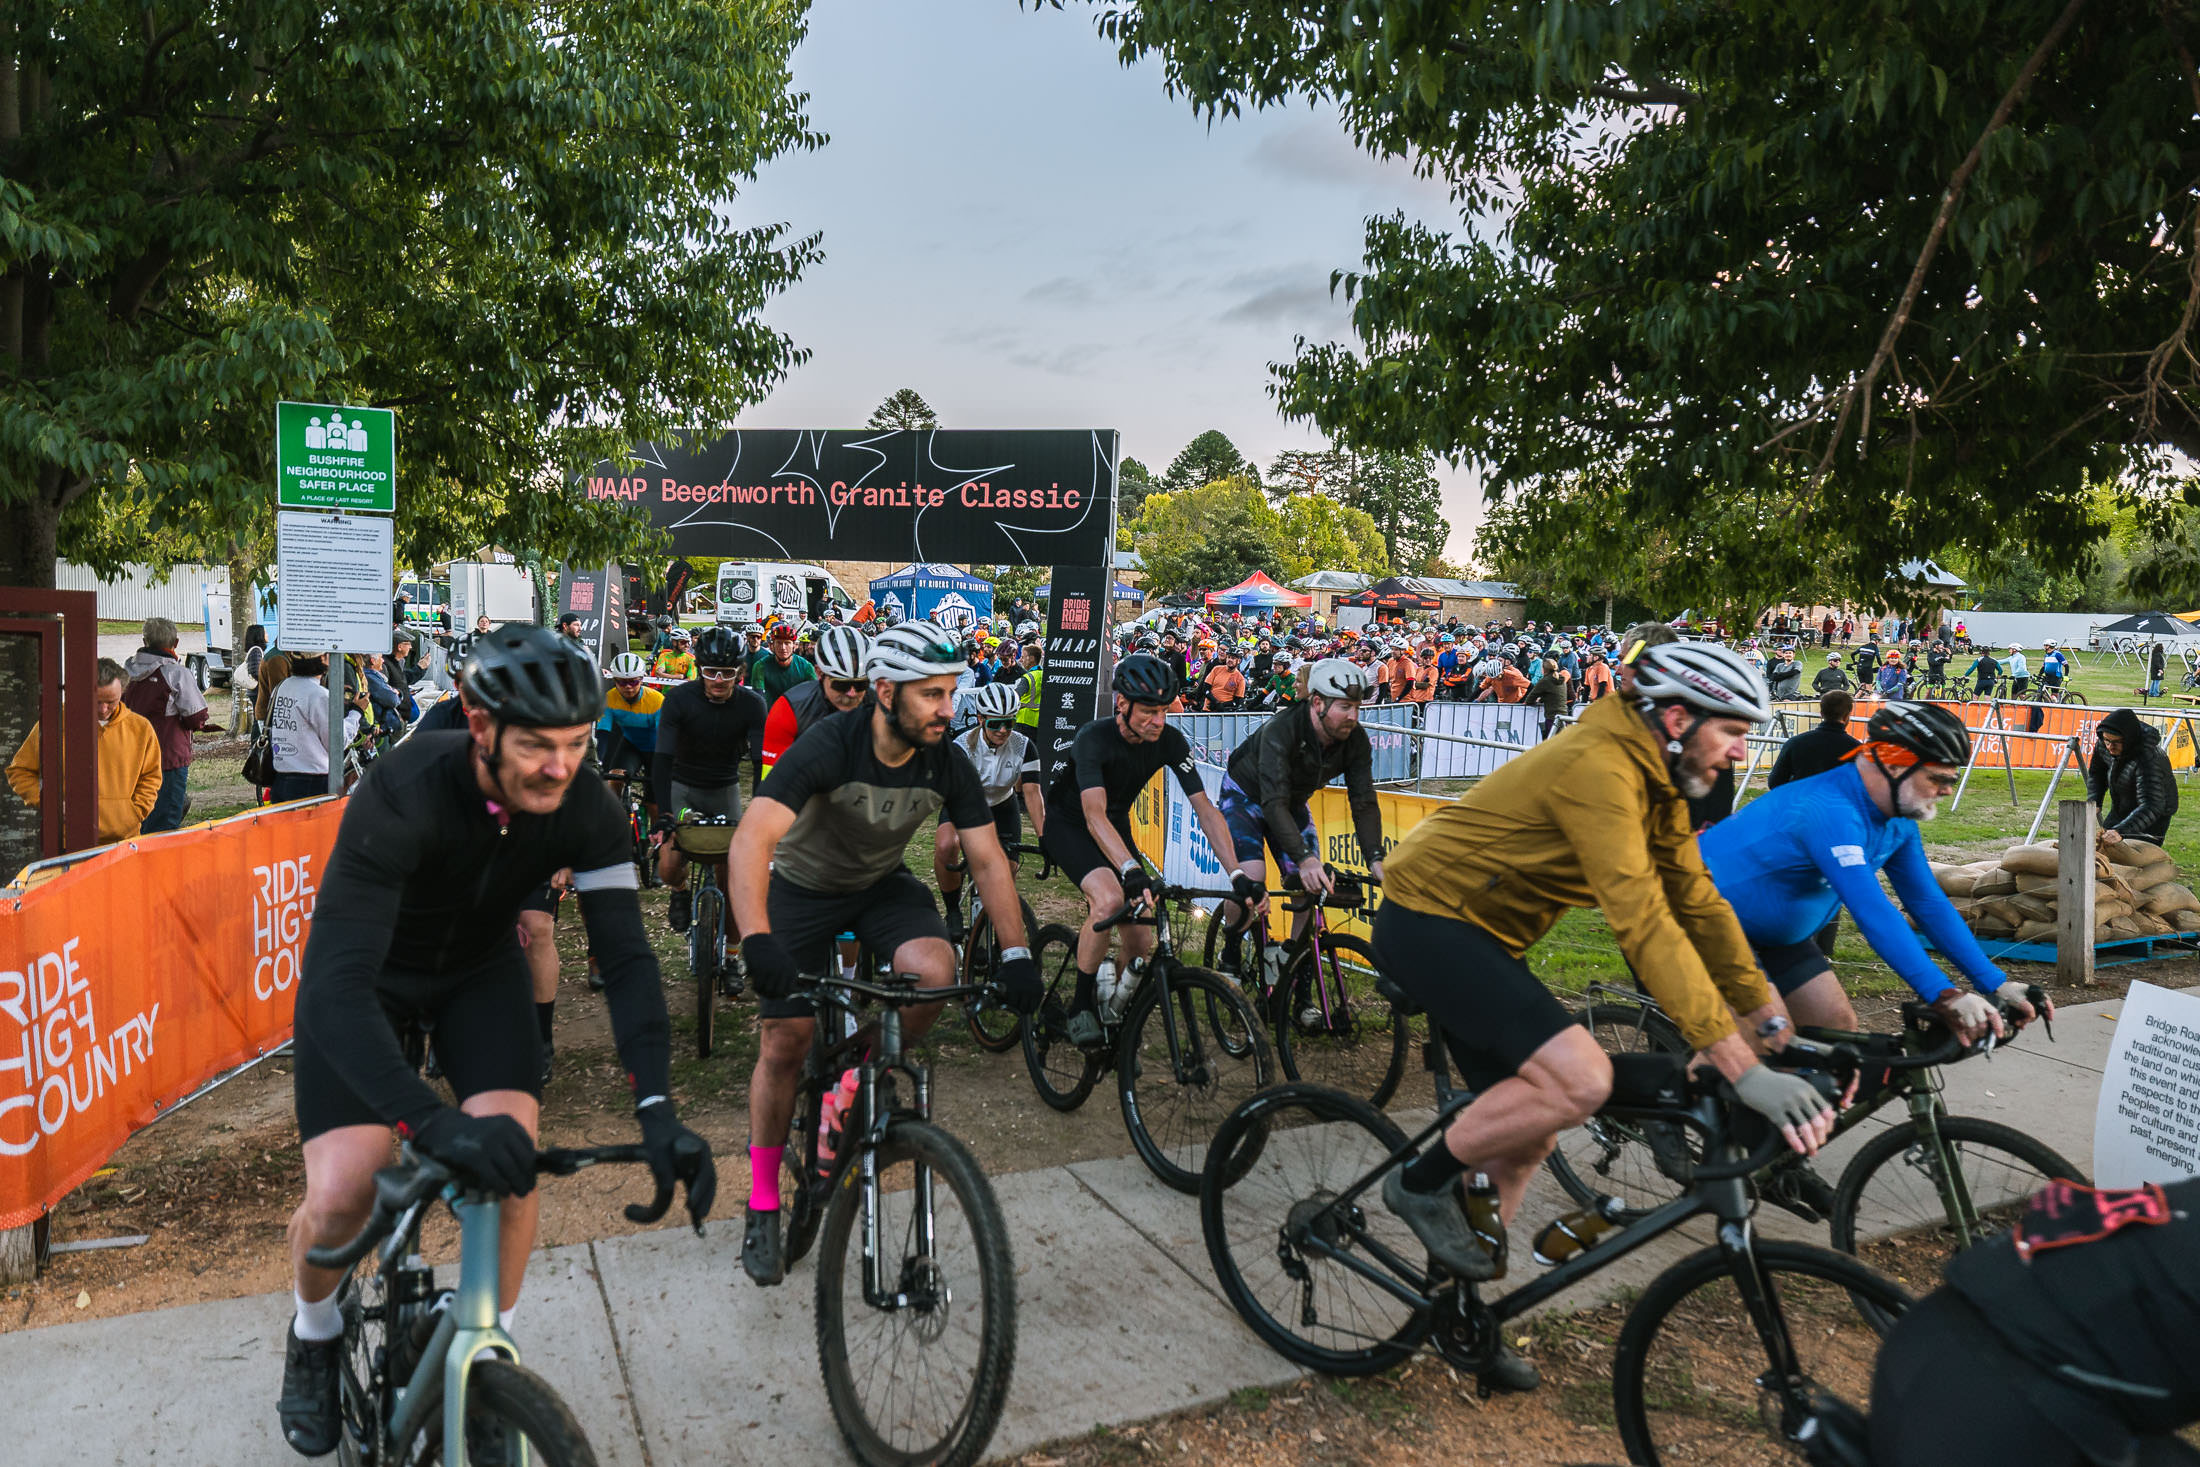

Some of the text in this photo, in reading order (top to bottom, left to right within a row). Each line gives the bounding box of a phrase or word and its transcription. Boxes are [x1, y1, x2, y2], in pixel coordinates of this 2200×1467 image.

[287, 466, 386, 480] NEIGHBOURHOOD
[309, 454, 365, 467] BUSHFIRE
[299, 480, 375, 493] SAFER PLACE
[587, 477, 1080, 509] MAAP Beechworth Granite Classic
[919, 579, 927, 588] BY
[928, 580, 949, 589] RIDERS
[969, 583, 989, 592] RIDERS
[1063, 598, 1090, 609] BRIDGE
[1061, 622, 1089, 631] BREWERS
[1049, 637, 1097, 652] MAAP
[1048, 659, 1095, 669] SHIMANO
[1047, 675, 1093, 685] SPECIALIZED
[853, 795, 921, 813] FOX
[253, 854, 316, 906] RIDE
[253, 894, 316, 958] HIGH
[0, 936, 89, 1027] RIDE
[2145, 1014, 2178, 1034] Bridge
[0, 990, 96, 1088] HIGH
[2132, 1040, 2181, 1064] traditional
[2124, 1051, 2139, 1063] the
[2141, 1056, 2163, 1072] land
[2164, 1066, 2177, 1077] on
[0, 1002, 160, 1156] COUNTRY
[2130, 1067, 2200, 1100] this event and
[2121, 1090, 2194, 1128] Peoples of this
[2132, 1083, 2174, 1105] respects
[2177, 1099, 2187, 1110] to
[2118, 1104, 2140, 1120] their
[2141, 1115, 2175, 1134] culture
[2178, 1130, 2199, 1144] and
[2130, 1124, 2196, 1158] past, present
[2146, 1145, 2196, 1174] emerging.
